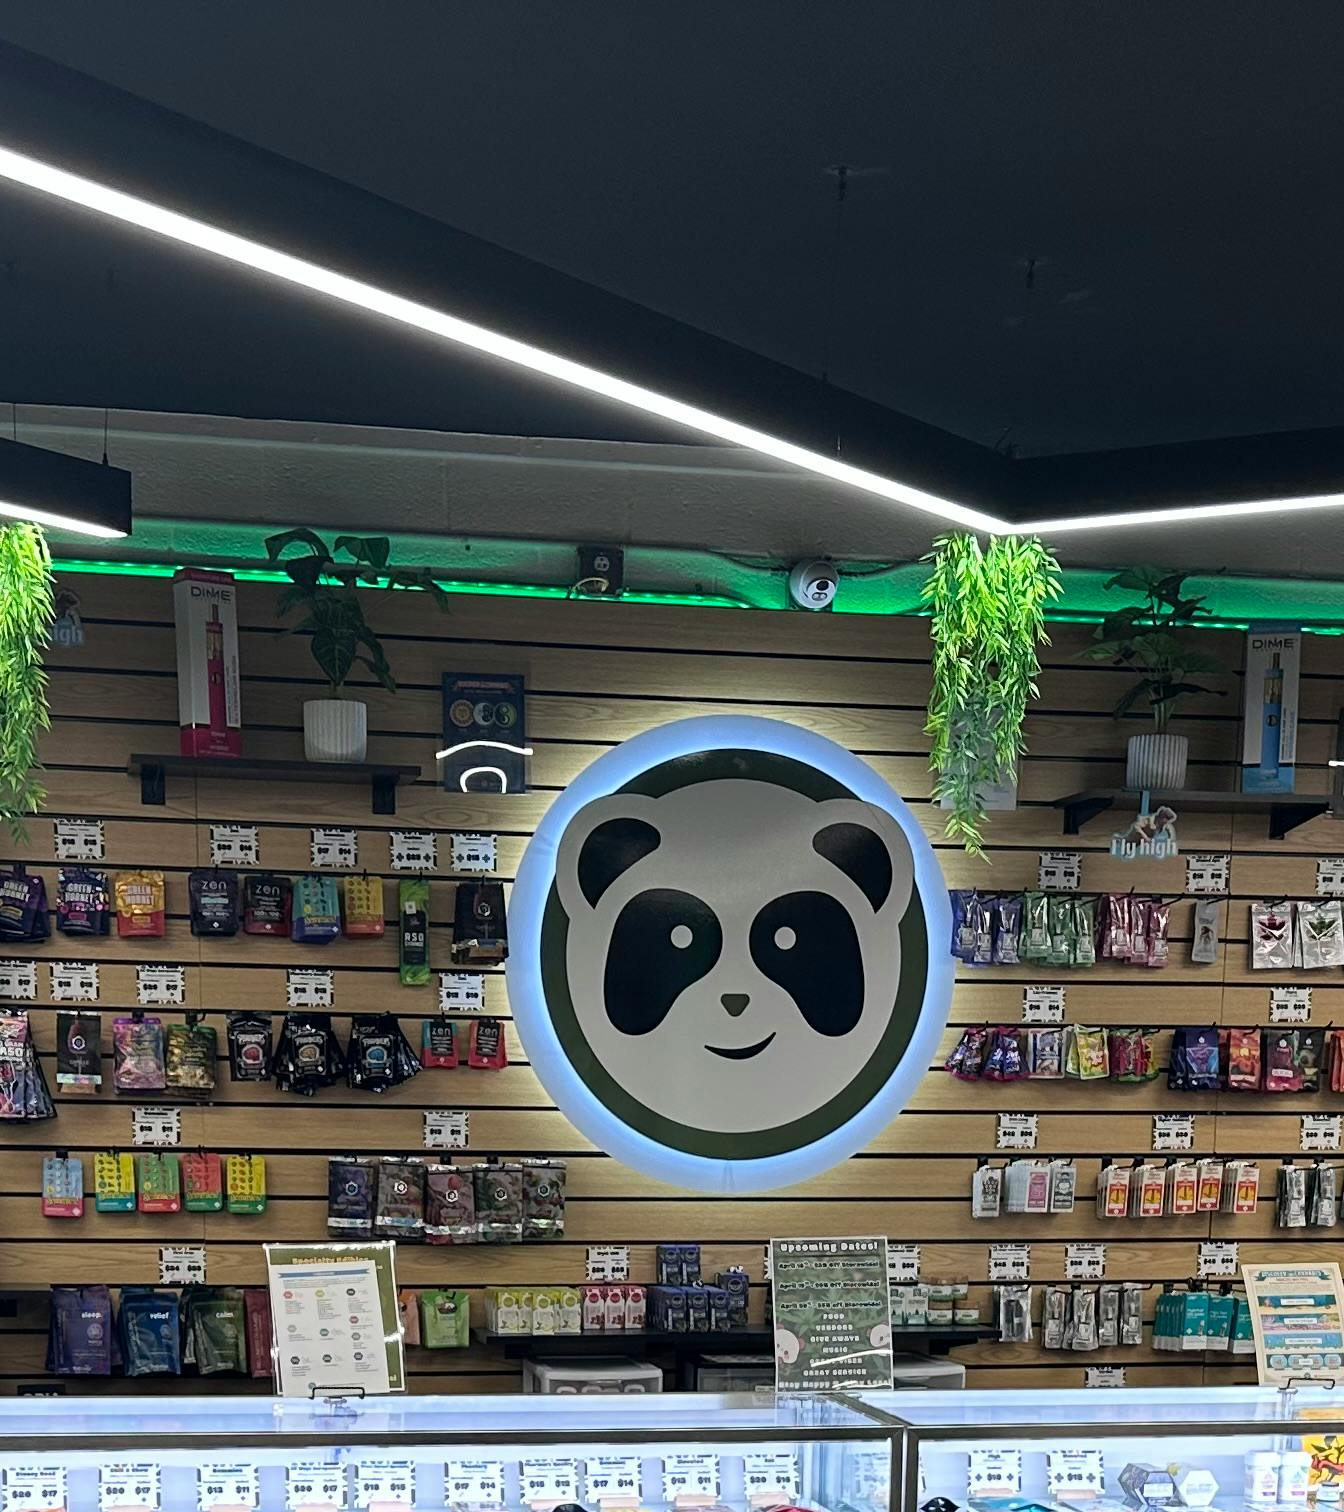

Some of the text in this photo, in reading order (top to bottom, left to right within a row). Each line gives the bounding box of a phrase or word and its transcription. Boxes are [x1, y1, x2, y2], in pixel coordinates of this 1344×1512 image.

[1140, 839, 1177, 859] high
[4, 881, 29, 892] GREEN
[201, 880, 228, 890] zen
[256, 884, 281, 896] zen
[405, 932, 425, 942] RSO
[780, 1242, 837, 1252] Upcoming
[215, 1311, 234, 1319] calm
